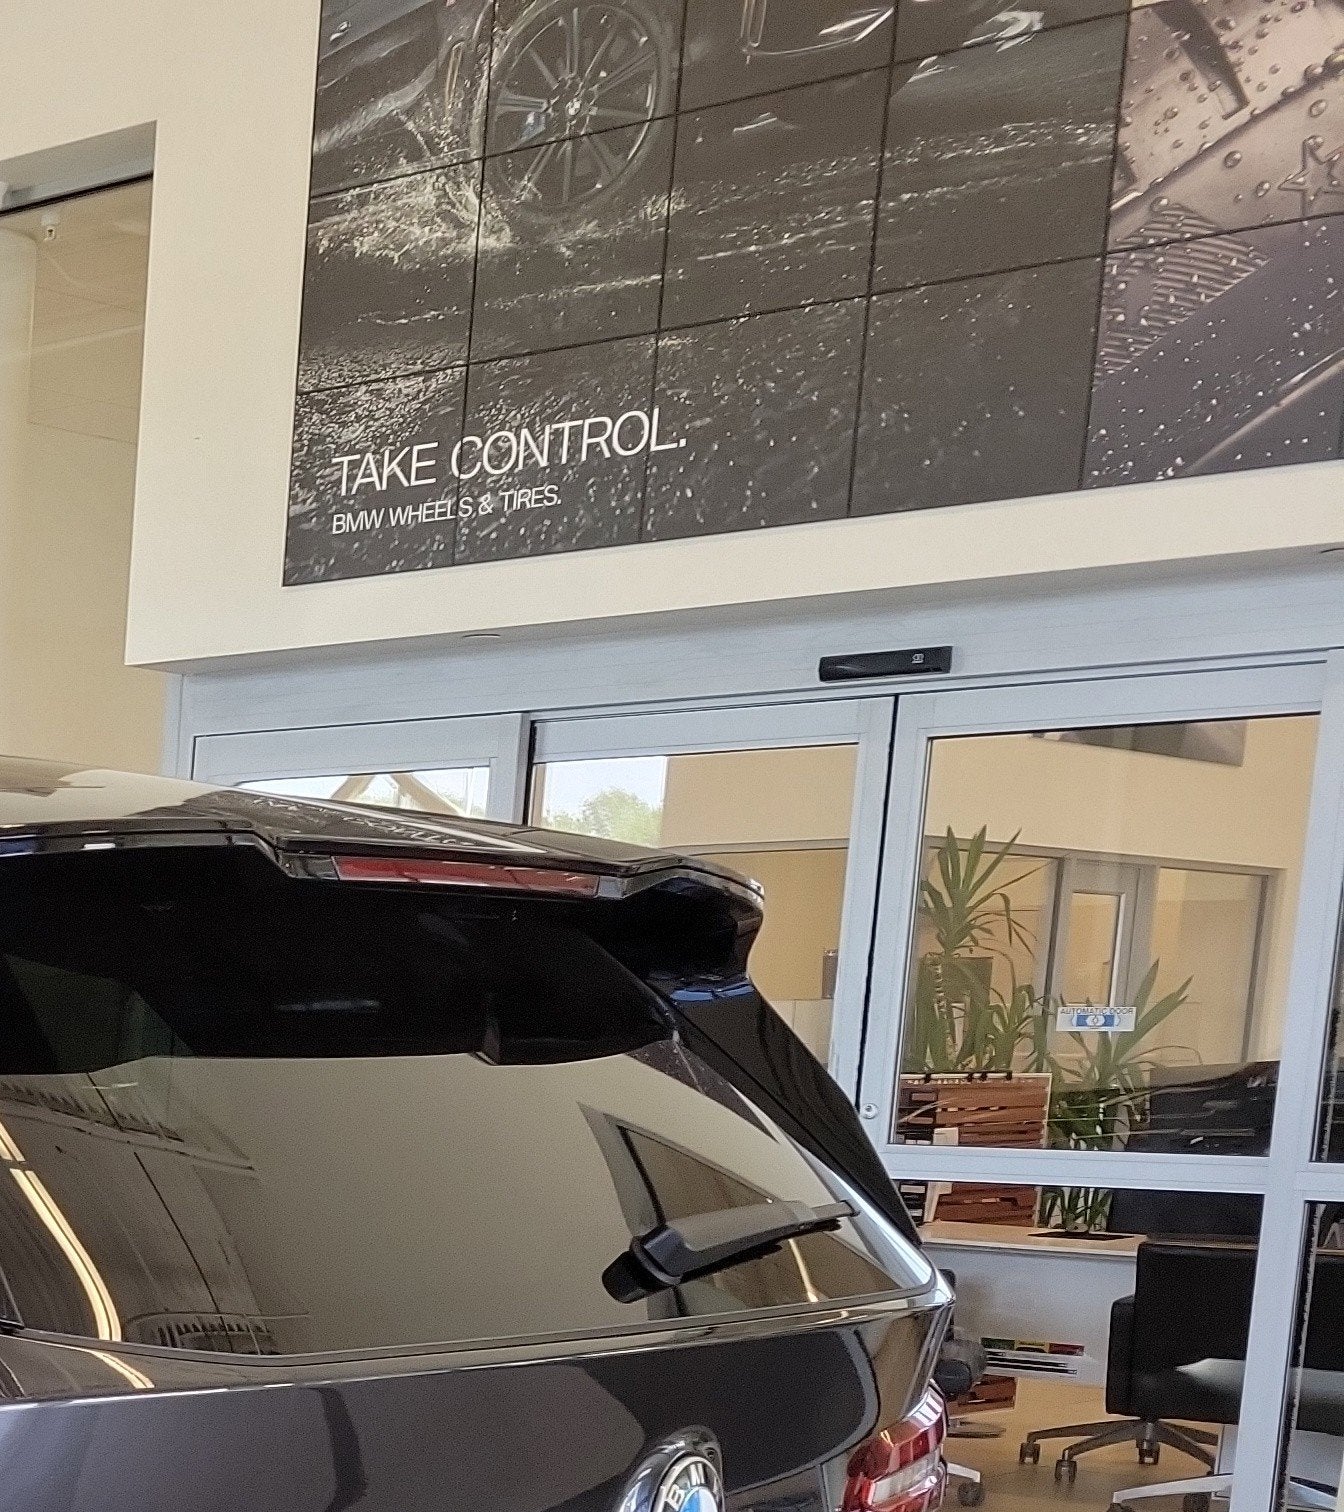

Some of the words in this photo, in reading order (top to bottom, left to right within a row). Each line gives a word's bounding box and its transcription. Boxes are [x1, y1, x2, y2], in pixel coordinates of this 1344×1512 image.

[331, 441, 439, 497] TAKE
[450, 406, 687, 481] CONTROL.
[331, 508, 385, 535] BMW
[389, 496, 474, 526] WHEELS
[478, 495, 494, 514] &
[499, 485, 563, 512] TIRES.
